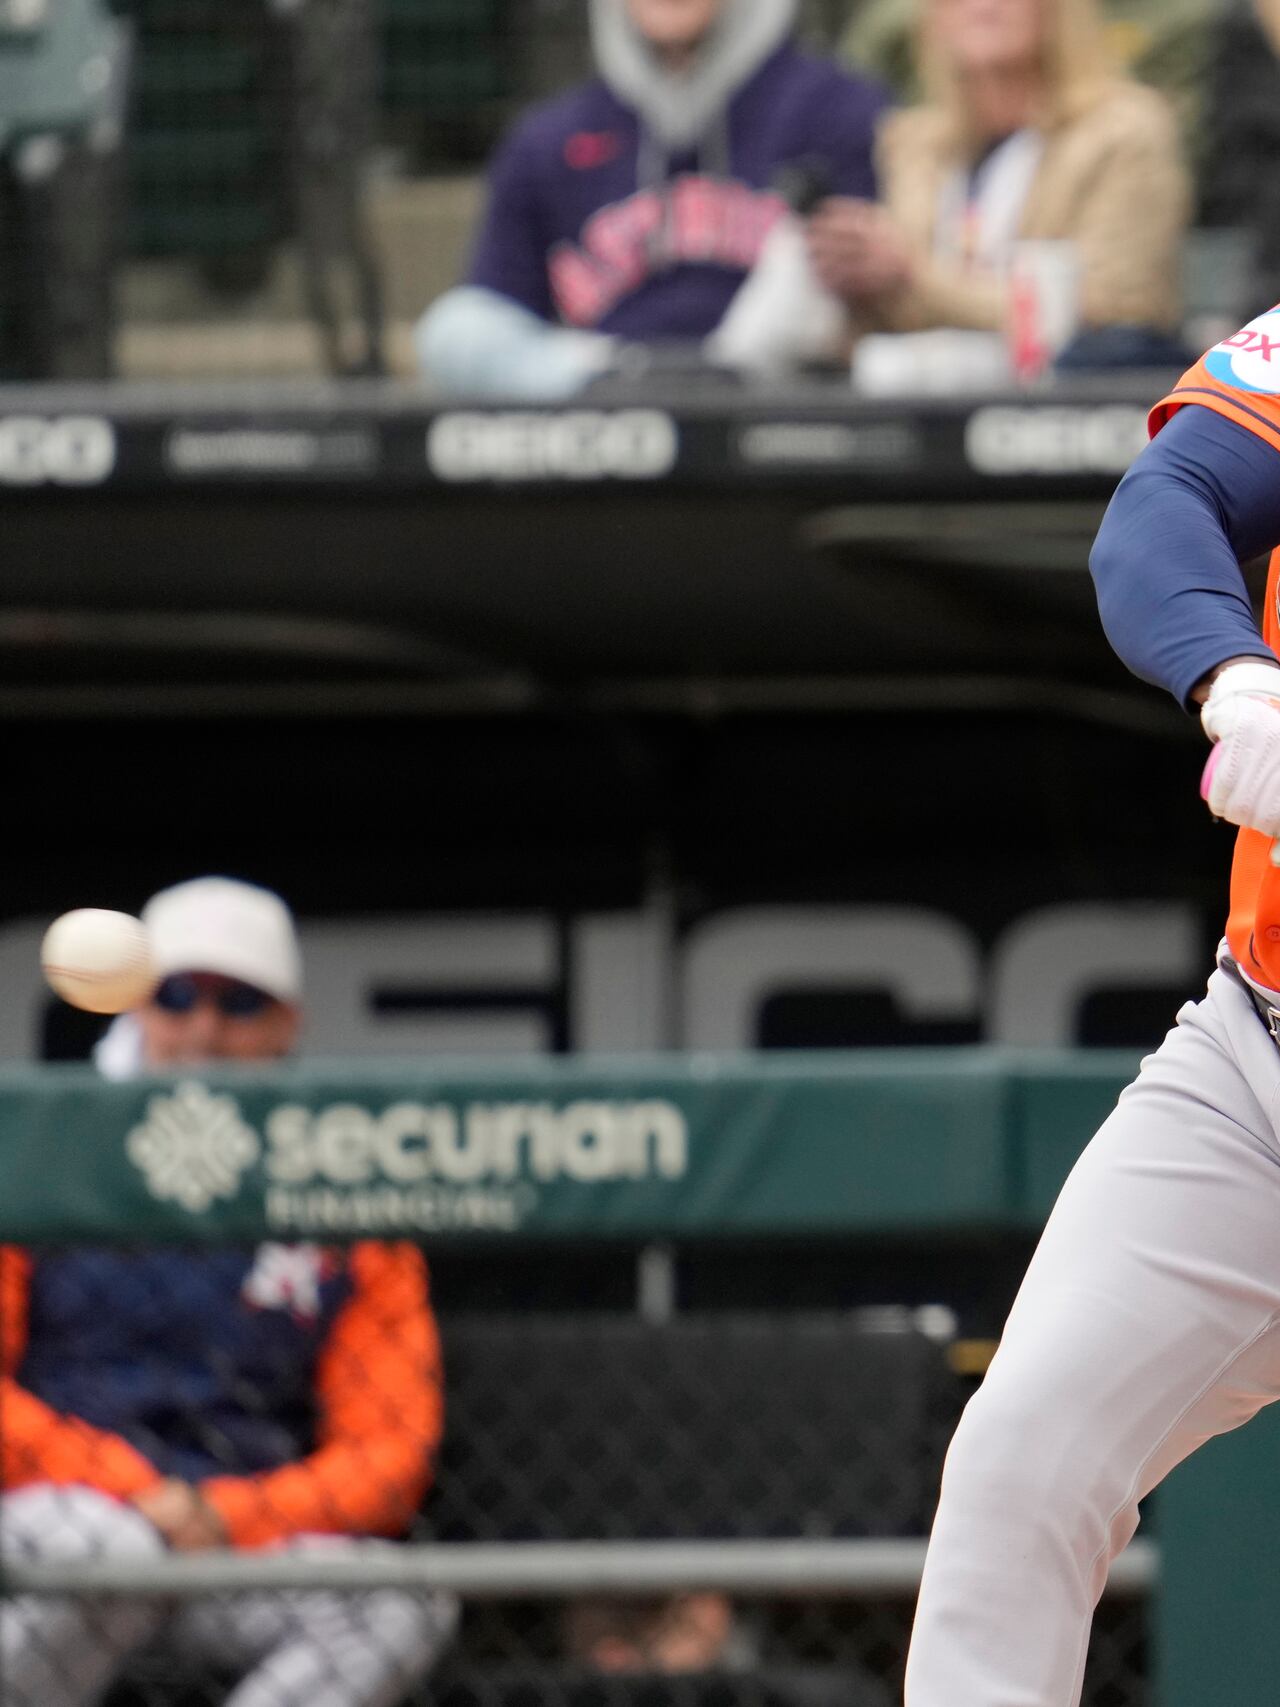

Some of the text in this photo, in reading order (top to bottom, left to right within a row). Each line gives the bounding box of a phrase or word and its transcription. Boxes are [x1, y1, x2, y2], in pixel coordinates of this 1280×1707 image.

[427, 409, 677, 482] GEICO
[966, 405, 1151, 474] GEIC
[267, 1102, 688, 1183] securian
